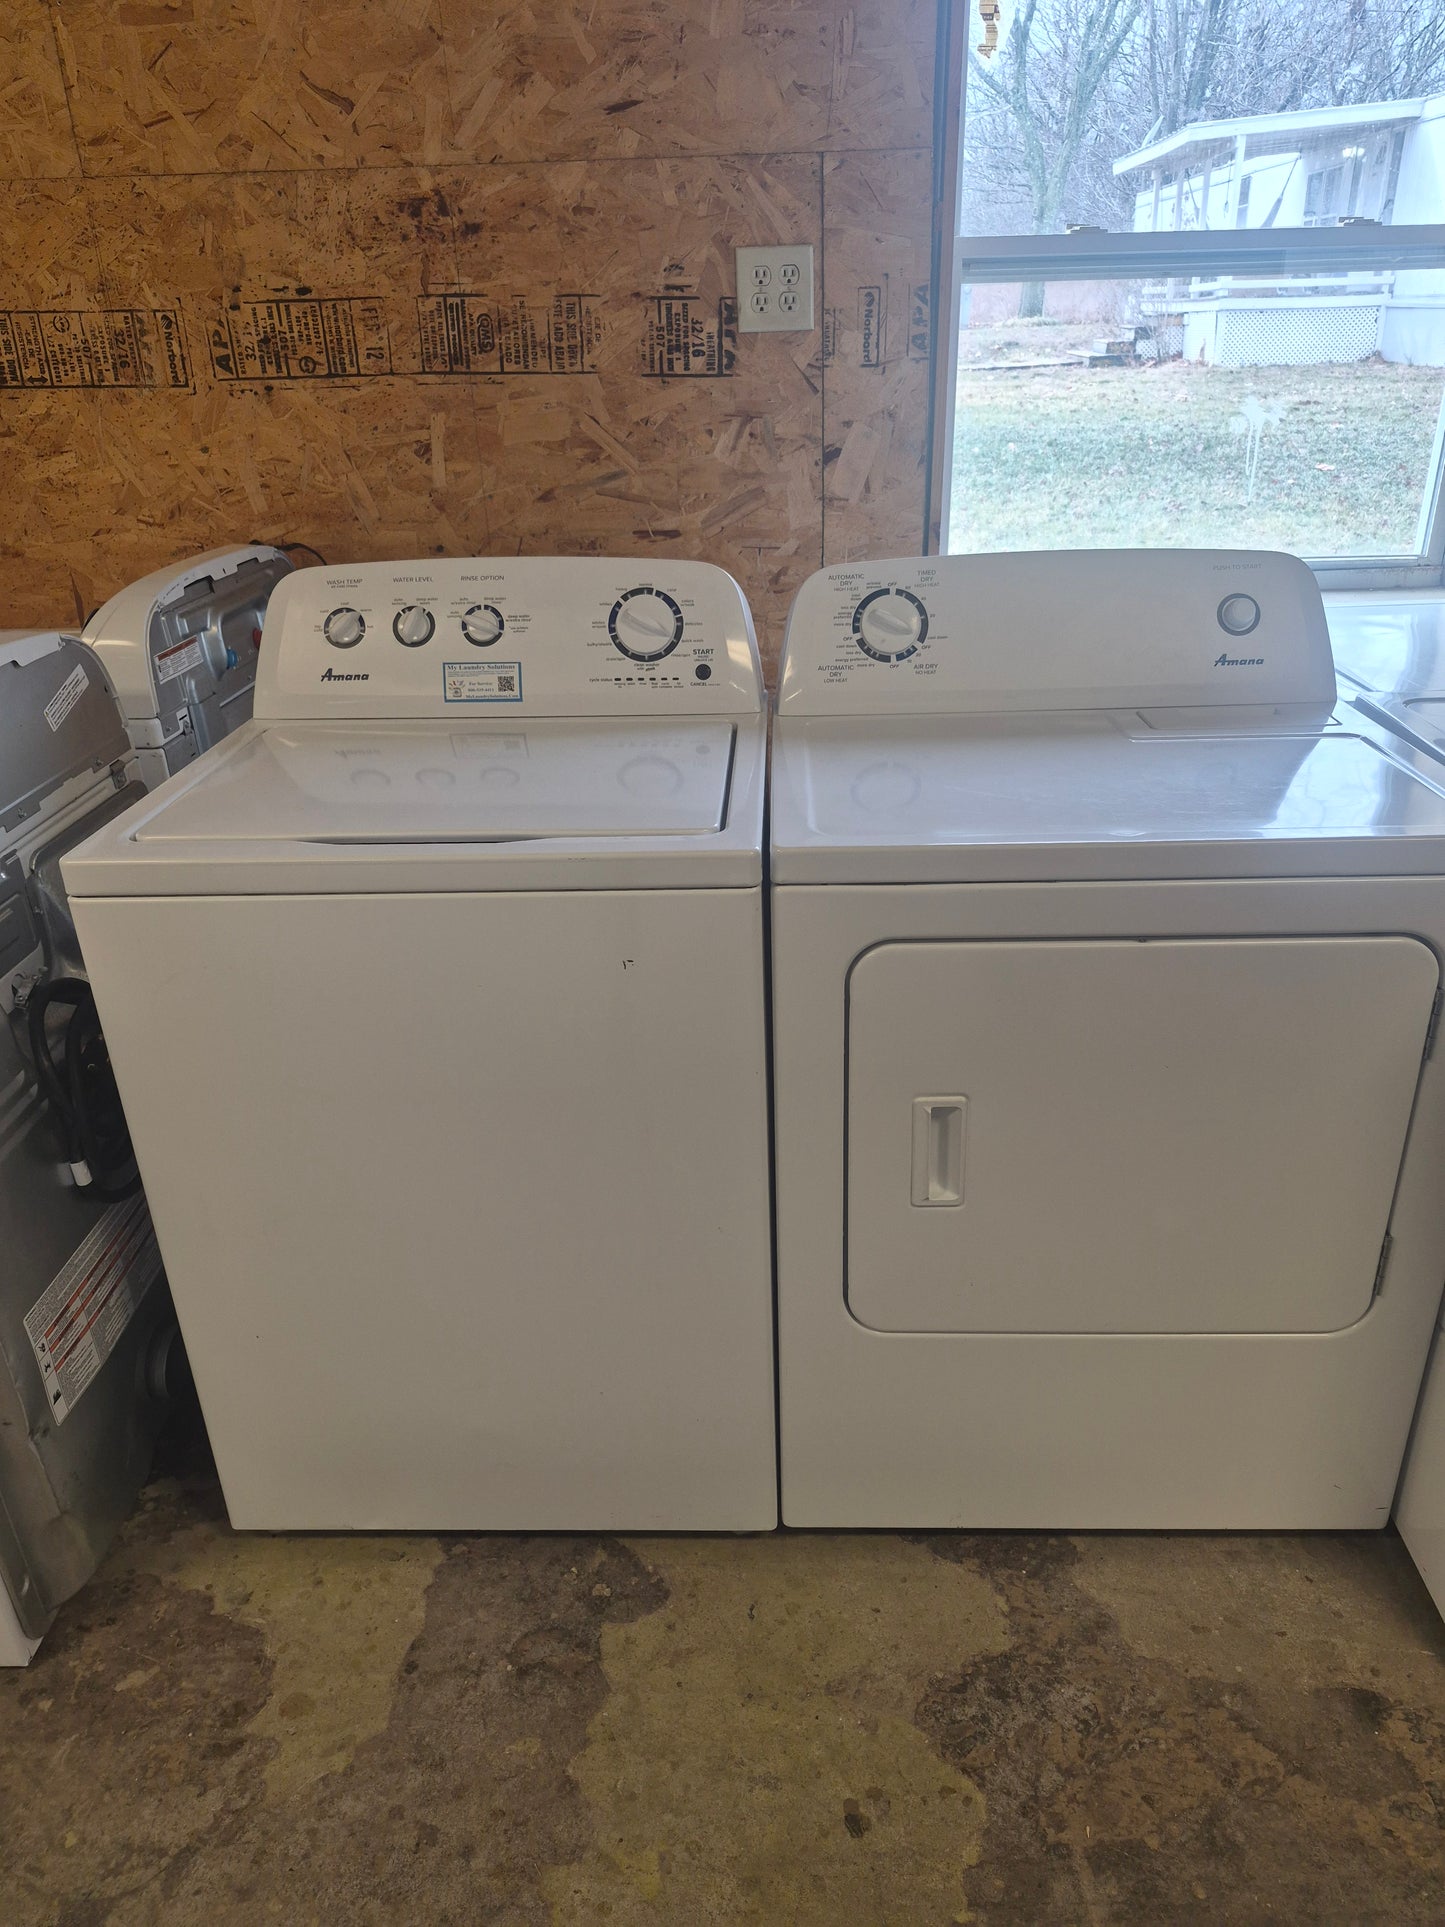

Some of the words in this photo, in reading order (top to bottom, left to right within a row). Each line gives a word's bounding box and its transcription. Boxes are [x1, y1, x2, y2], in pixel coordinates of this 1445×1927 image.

[251, 307, 261, 337] SPACING
[310, 305, 321, 339] CATEGORY
[566, 303, 577, 320] THIS
[910, 284, 929, 353] APA
[30, 316, 42, 356] STRENGTH
[278, 330, 290, 351] 507
[554, 322, 564, 342] LADO
[567, 323, 577, 341] SIDE
[656, 326, 666, 348] 507
[691, 317, 706, 358] 32/16
[863, 309, 873, 363] Norbord
[2, 338, 13, 355] SIDE
[81, 338, 92, 359] 507
[115, 329, 130, 368] 32/16
[366, 346, 385, 360] 12
[164, 331, 181, 384] Norbord
[554, 346, 566, 370] ABAJO
[6, 360, 19, 382] DOWN
[828, 573, 865, 581] AUTOMATIC
[692, 648, 714, 656] START
[1213, 653, 1265, 667] Amana
[320, 667, 370, 682] Amana
[459, 664, 485, 672] Laundry
